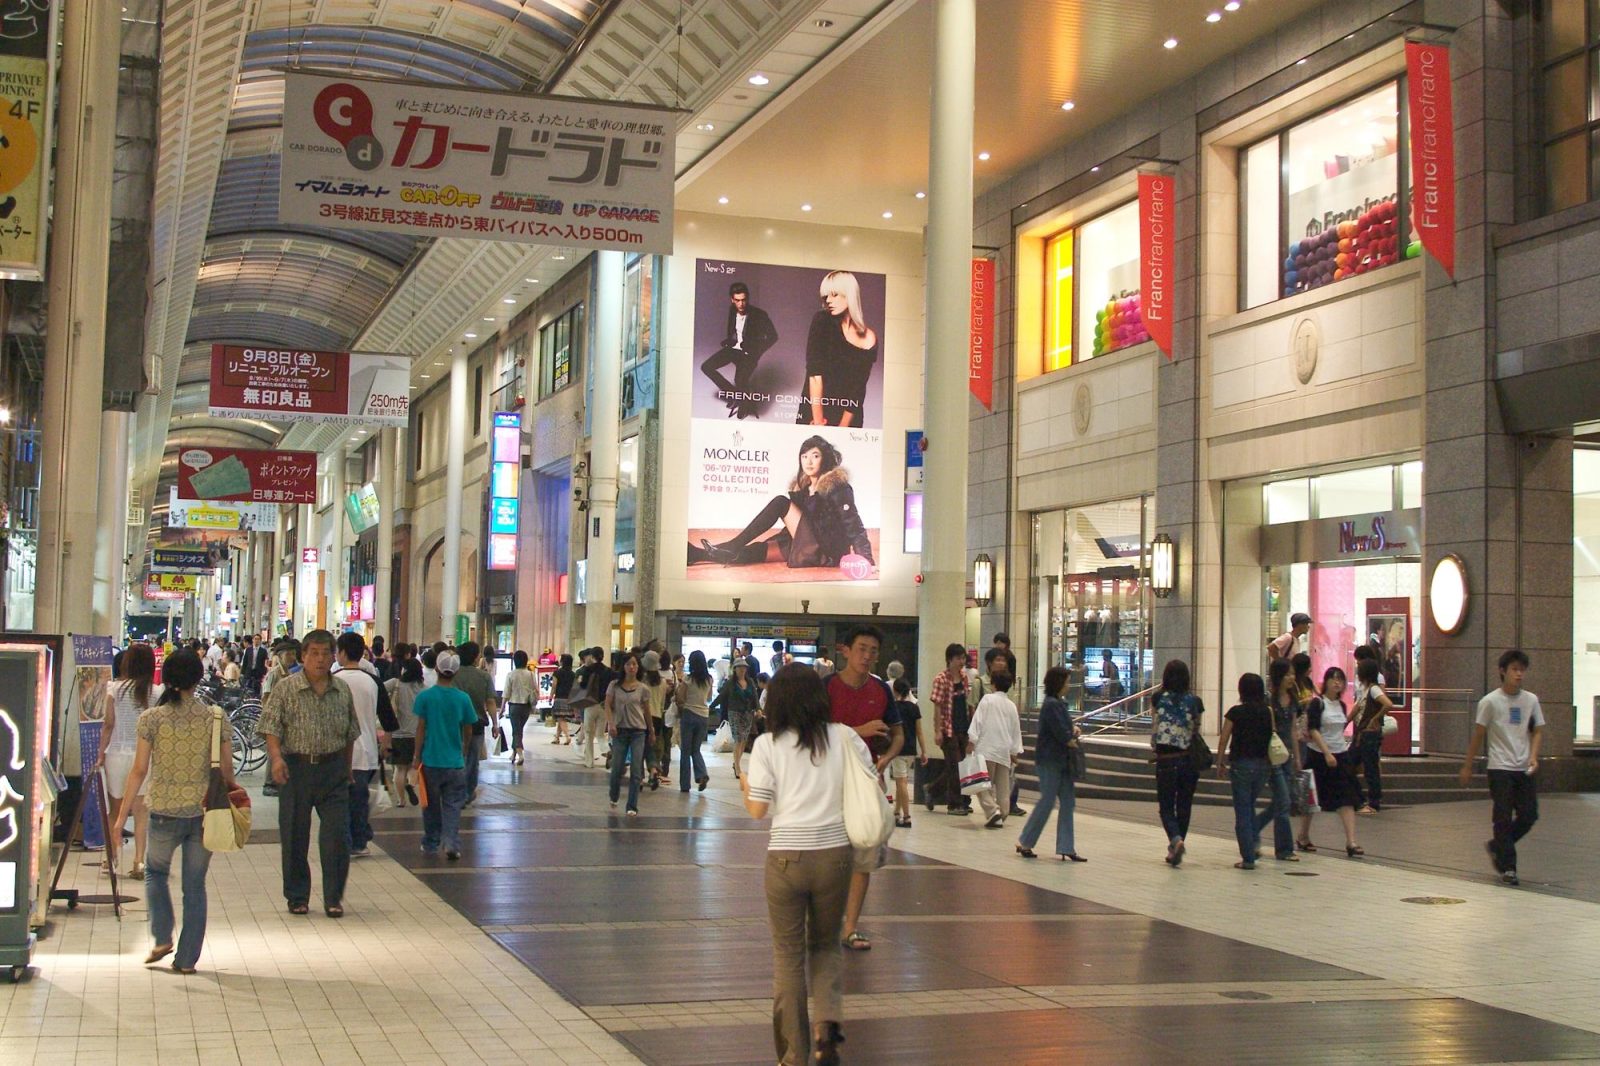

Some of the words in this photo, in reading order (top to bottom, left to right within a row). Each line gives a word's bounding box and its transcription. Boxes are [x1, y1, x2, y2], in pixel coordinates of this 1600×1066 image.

[0, 72, 42, 86] PRIVATE
[9, 100, 40, 120] 4F
[1420, 50, 1440, 229] Francfranc
[289, 142, 306, 152] CAR
[307, 144, 343, 155] DORADO
[391, 115, 661, 187] カードラド
[294, 180, 390, 198] イマムラオート
[573, 202, 597, 217] UP
[598, 205, 662, 224] GARAGE
[1148, 179, 1165, 320] Francfranc
[970, 263, 985, 379] Francfranc
[229, 361, 330, 378] リニューアルオープン
[243, 387, 312, 408] 無印良品
[370, 393, 409, 409] 250m先
[718, 389, 771, 402] FRENCH
[775, 394, 859, 408] CONNECTION
[703, 448, 770, 462] MONCLER
[259, 462, 312, 479] ポイントアップ
[733, 465, 769, 475] WINTER
[271, 479, 299, 487] プレゼント
[702, 474, 769, 485] COLLECTION
[179, 554, 206, 564] ジオス
[304, 549, 317, 562] 本
